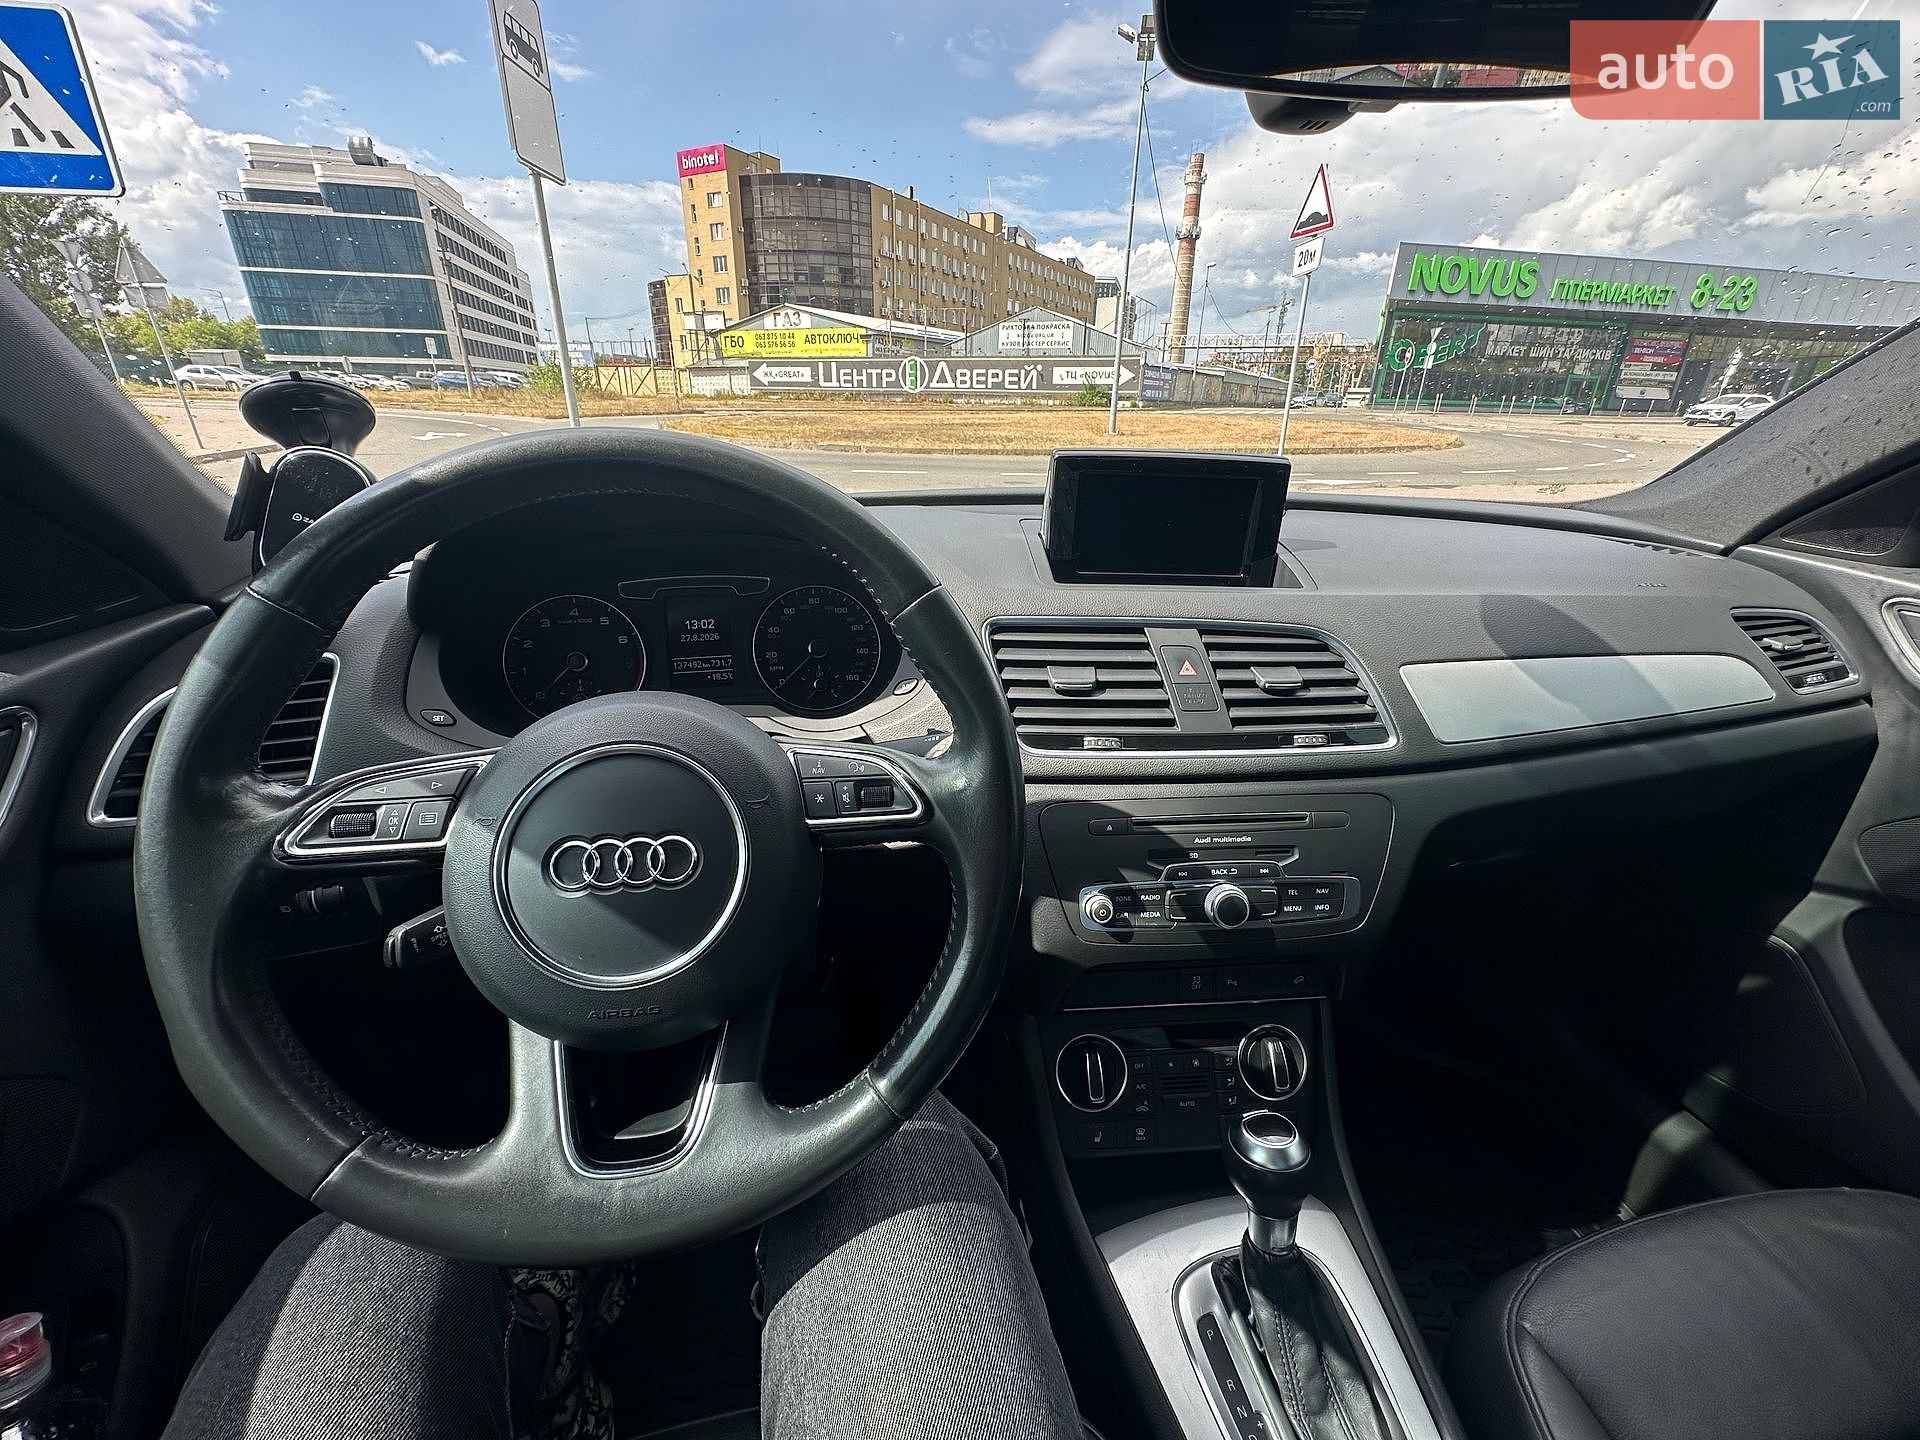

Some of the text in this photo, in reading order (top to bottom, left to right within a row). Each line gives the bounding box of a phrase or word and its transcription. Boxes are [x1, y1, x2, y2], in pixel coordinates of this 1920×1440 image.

[681, 149, 720, 170] binotel
[1407, 251, 1539, 299] NOVUS
[1550, 278, 1676, 307] ГІПЕРМАРКЕТ
[1690, 273, 1758, 312] 8-23
[773, 311, 801, 328] ГАЗ
[724, 335, 744, 348] ГБО
[754, 333, 766, 341] 063
[804, 333, 860, 345] АВТОКЛЮЧ
[755, 341, 766, 349] 063
[788, 340, 796, 348] 56
[1486, 344, 1526, 357] МАРКЕТ
[1529, 346, 1554, 358] ШИН
[1573, 348, 1613, 362] ДИСКІВ
[1065, 370, 1077, 380] ТЦ
[808, 597, 820, 605] 80
[569, 607, 579, 616] 4
[783, 607, 796, 615] 60
[539, 618, 551, 628] 3
[600, 617, 610, 625] 5
[685, 619, 715, 629] 13:02
[617, 635, 629, 644] 6
[680, 633, 720, 642] 27.8.2026
[523, 639, 534, 649] 2
[856, 647, 869, 655] 140
[674, 661, 702, 669] 137492
[711, 659, 732, 667] 731.7
[388, 817, 399, 825] OK
[587, 1005, 661, 1019] AIRBAG
[1206, 1329, 1214, 1341] P
[1226, 1379, 1236, 1391] R
[1236, 1405, 1248, 1419] N
